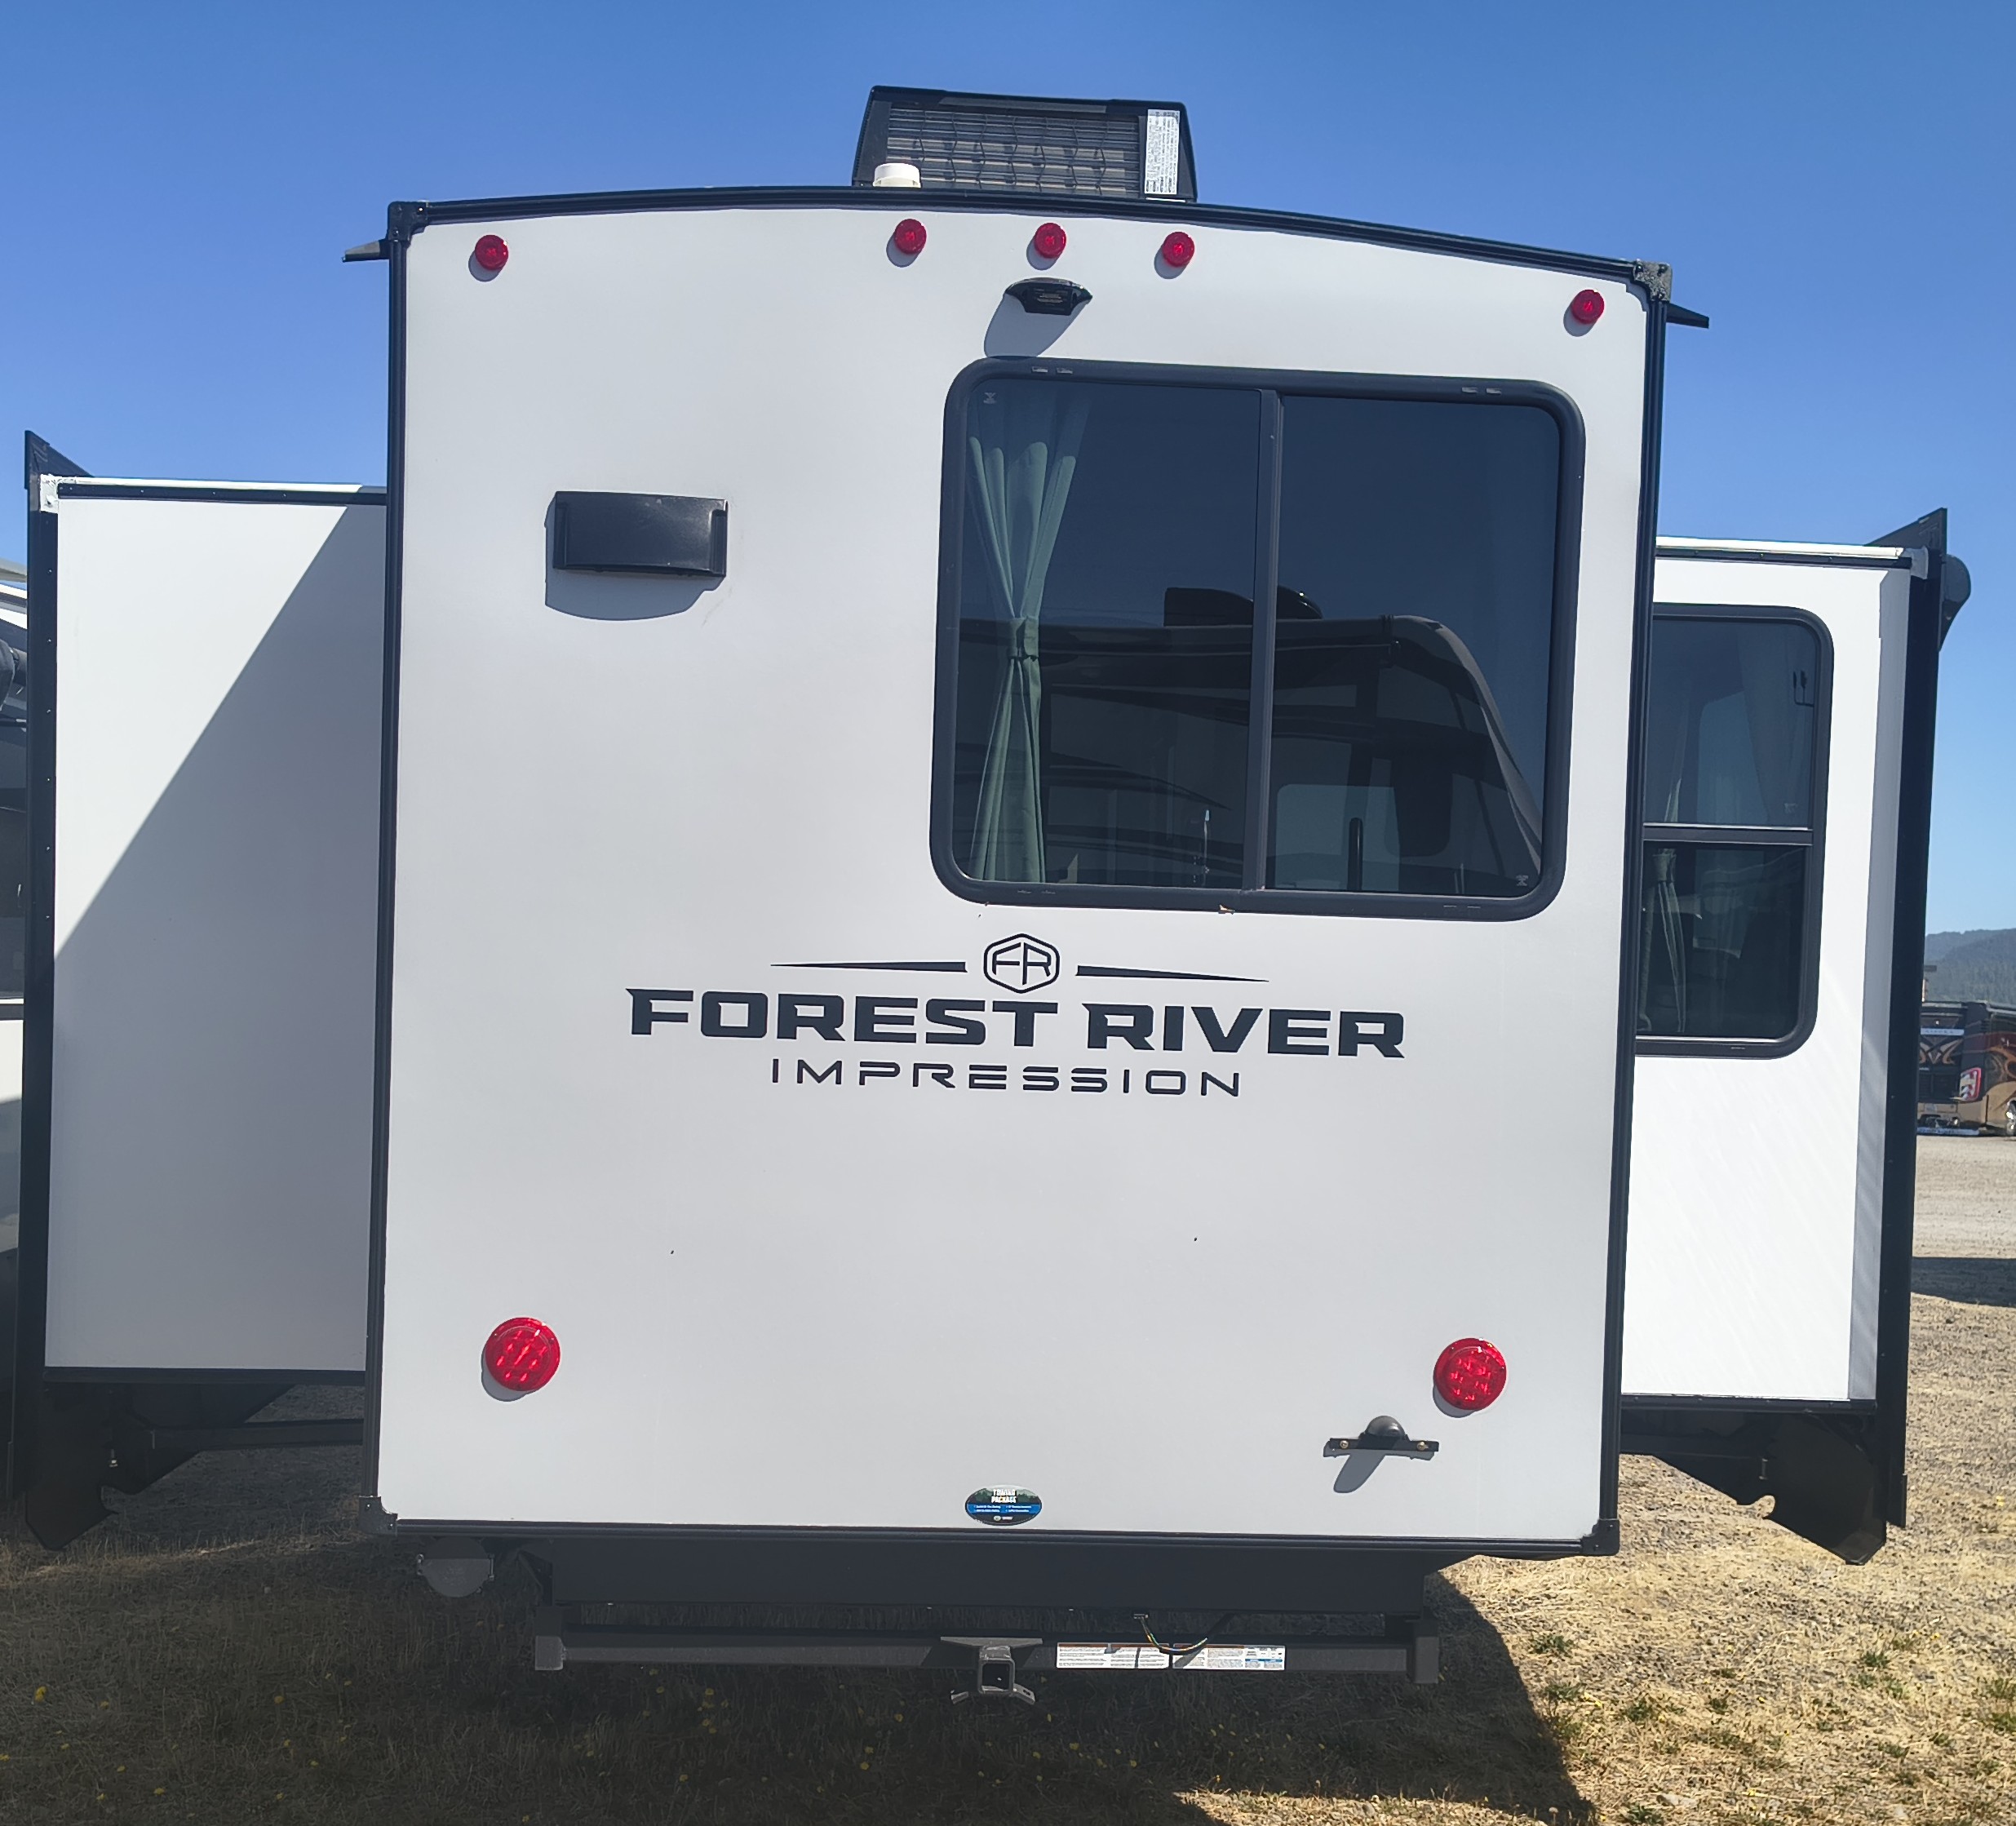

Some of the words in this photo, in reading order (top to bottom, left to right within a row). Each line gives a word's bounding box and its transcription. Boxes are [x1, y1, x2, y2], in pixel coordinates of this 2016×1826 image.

[990, 941, 1052, 986] FR
[625, 988, 1059, 1048] FOREST
[1081, 1003, 1405, 1059] RIVER
[772, 1058, 1239, 1097] IMPRESSION
